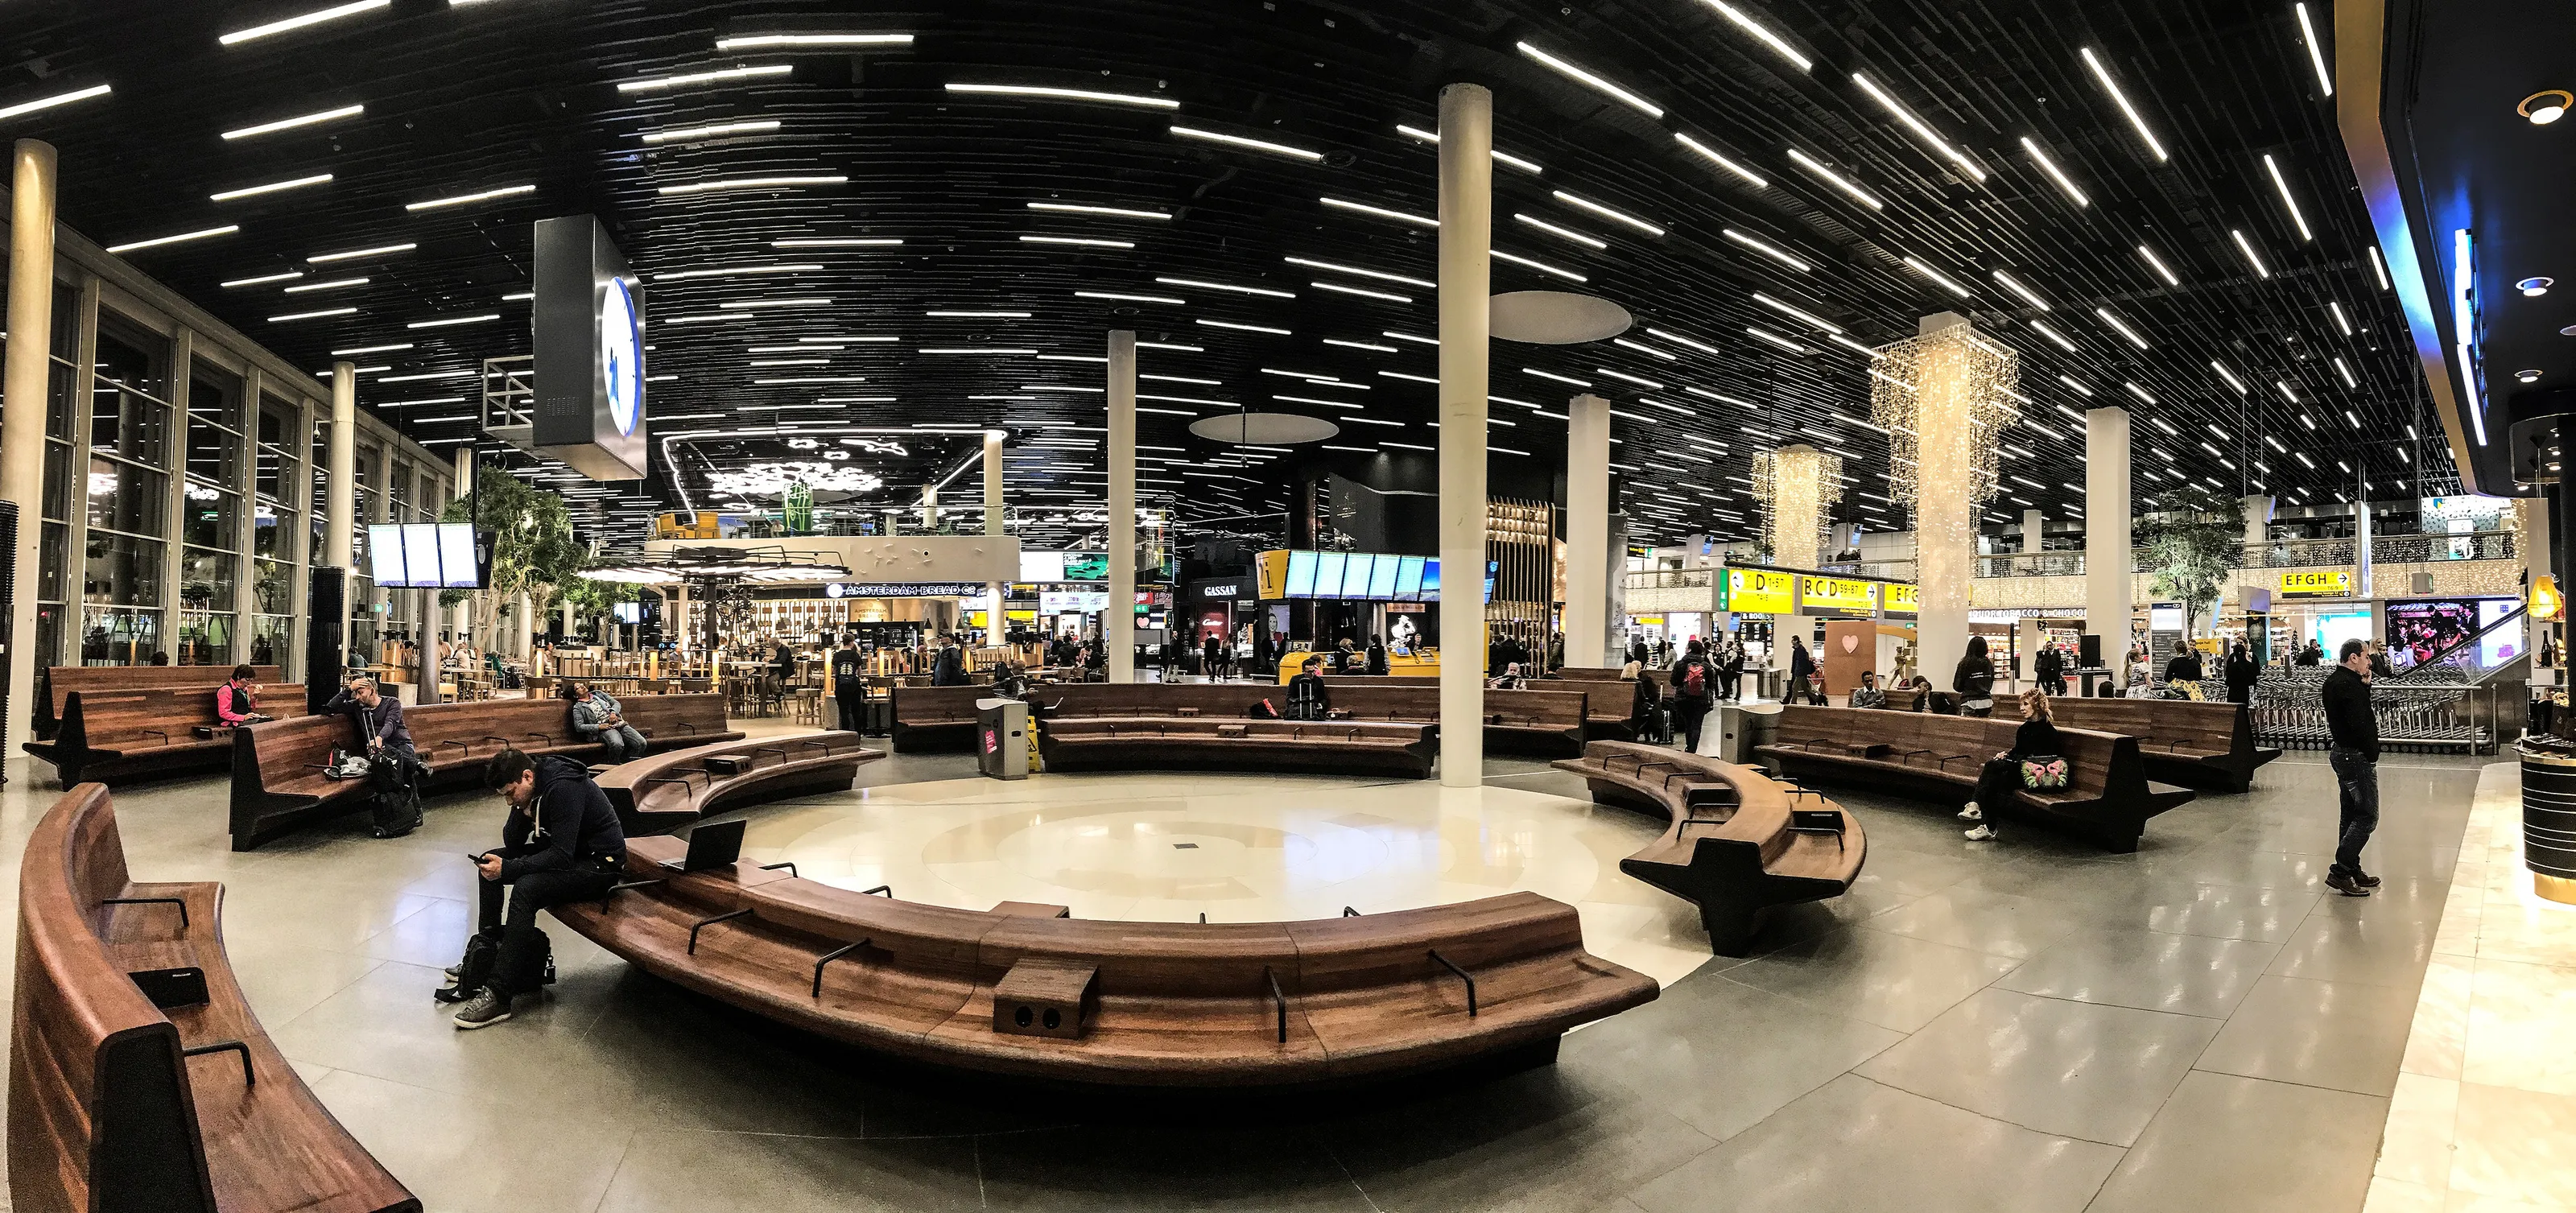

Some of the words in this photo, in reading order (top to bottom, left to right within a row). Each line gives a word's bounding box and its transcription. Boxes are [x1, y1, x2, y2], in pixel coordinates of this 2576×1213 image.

[1756, 574, 1765, 590] D
[845, 585, 918, 596] AMSTERDAM
[920, 585, 960, 596] BREAD
[1204, 585, 1237, 596] GASSAN
[1839, 584, 1859, 595] 59-87
[2000, 609, 2039, 617] TOBACCO
